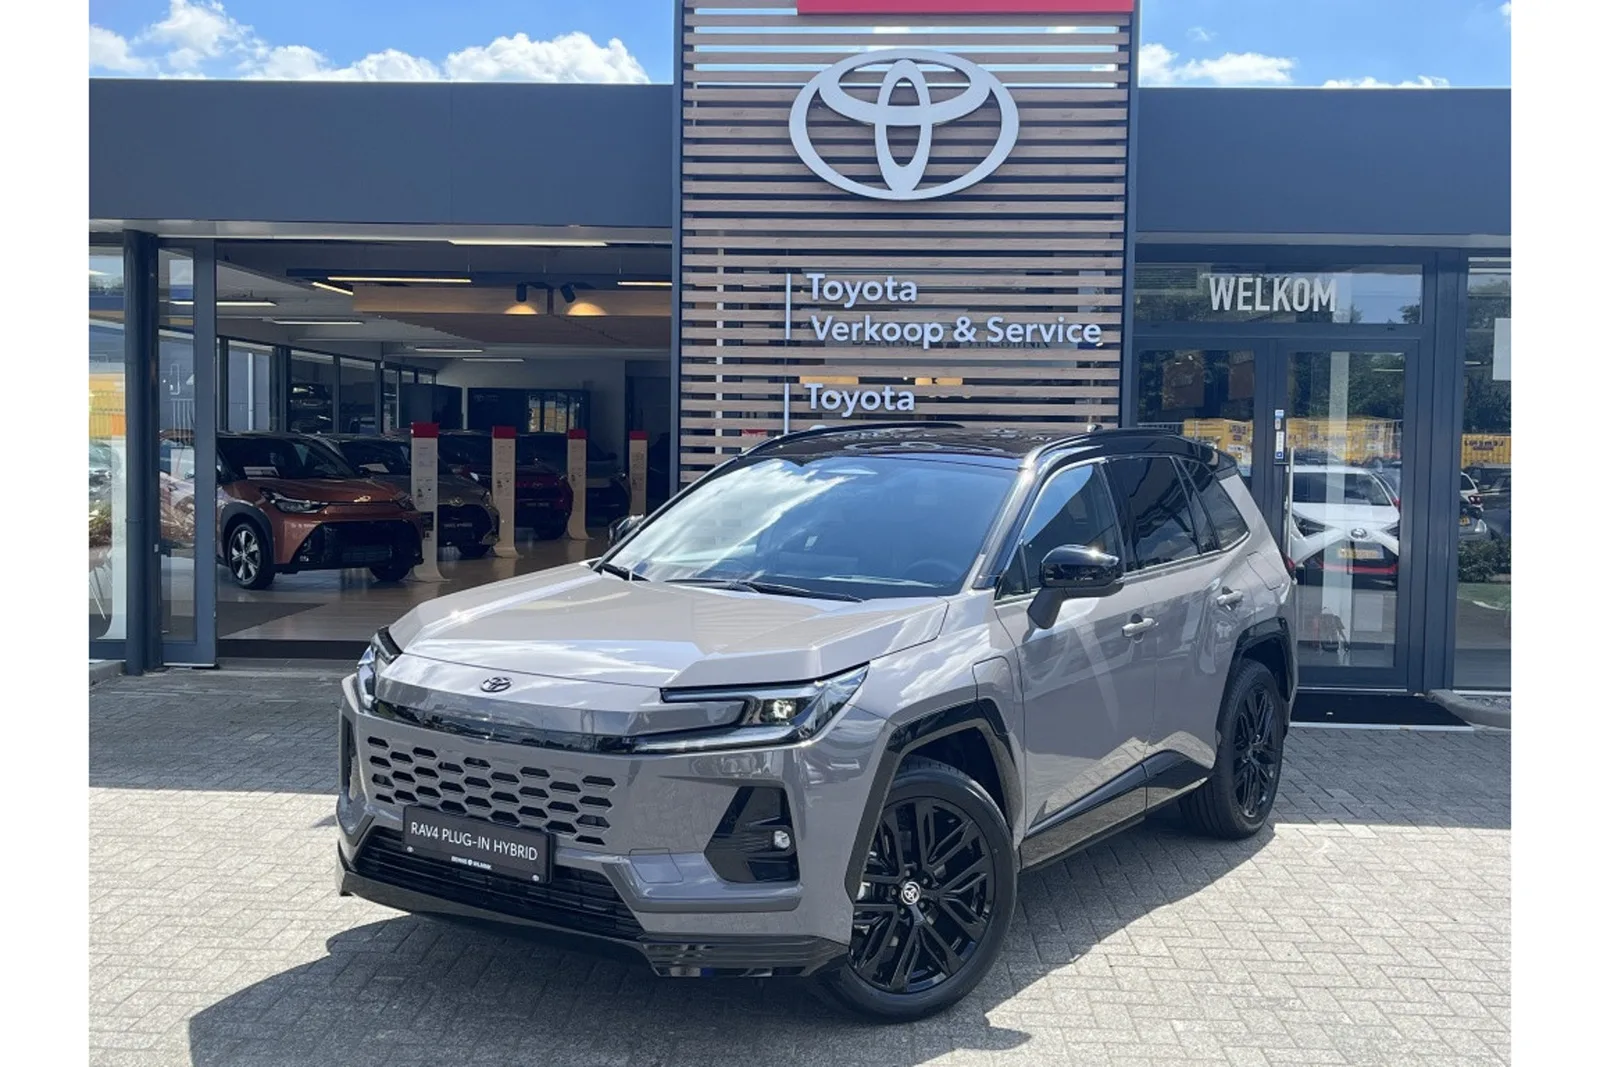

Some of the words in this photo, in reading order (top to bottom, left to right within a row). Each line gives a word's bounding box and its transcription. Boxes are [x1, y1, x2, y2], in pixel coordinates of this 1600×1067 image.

[806, 273, 917, 308] Toyota
[1209, 276, 1338, 312] WELKOM
[810, 314, 944, 350] Verkoop
[953, 316, 978, 342] &
[986, 316, 1102, 343] Service
[804, 383, 915, 418] Toyota
[410, 821, 439, 838] RAV4
[441, 828, 491, 850] PLUG-IN
[493, 840, 538, 861] HYBRID
